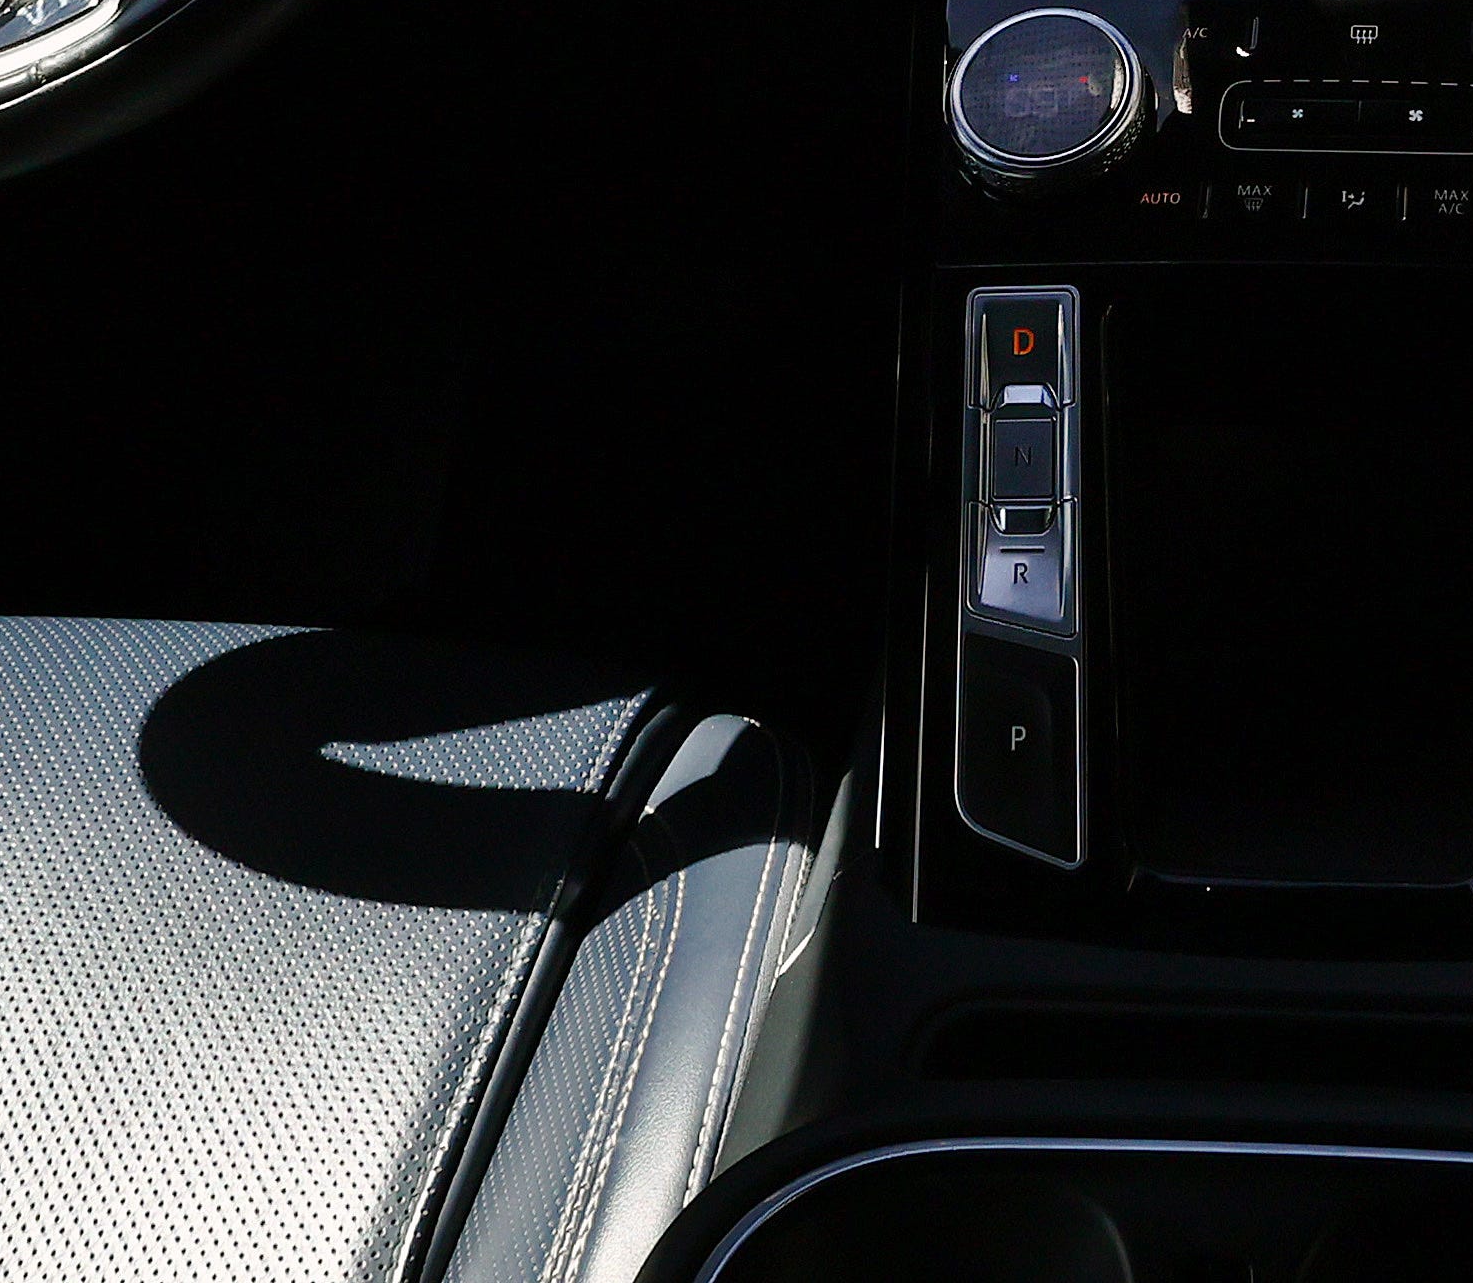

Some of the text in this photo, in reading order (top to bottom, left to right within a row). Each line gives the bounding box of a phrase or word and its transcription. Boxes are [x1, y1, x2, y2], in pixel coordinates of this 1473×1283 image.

[1182, 28, 1208, 40] A/C
[1237, 185, 1273, 196] MAX
[1434, 189, 1470, 202] MAX
[1140, 192, 1181, 204] AUTO
[1438, 203, 1465, 215] A/C
[1013, 327, 1035, 356] D
[1014, 447, 1032, 465] N
[1013, 562, 1029, 585] R
[1011, 725, 1027, 752] P
